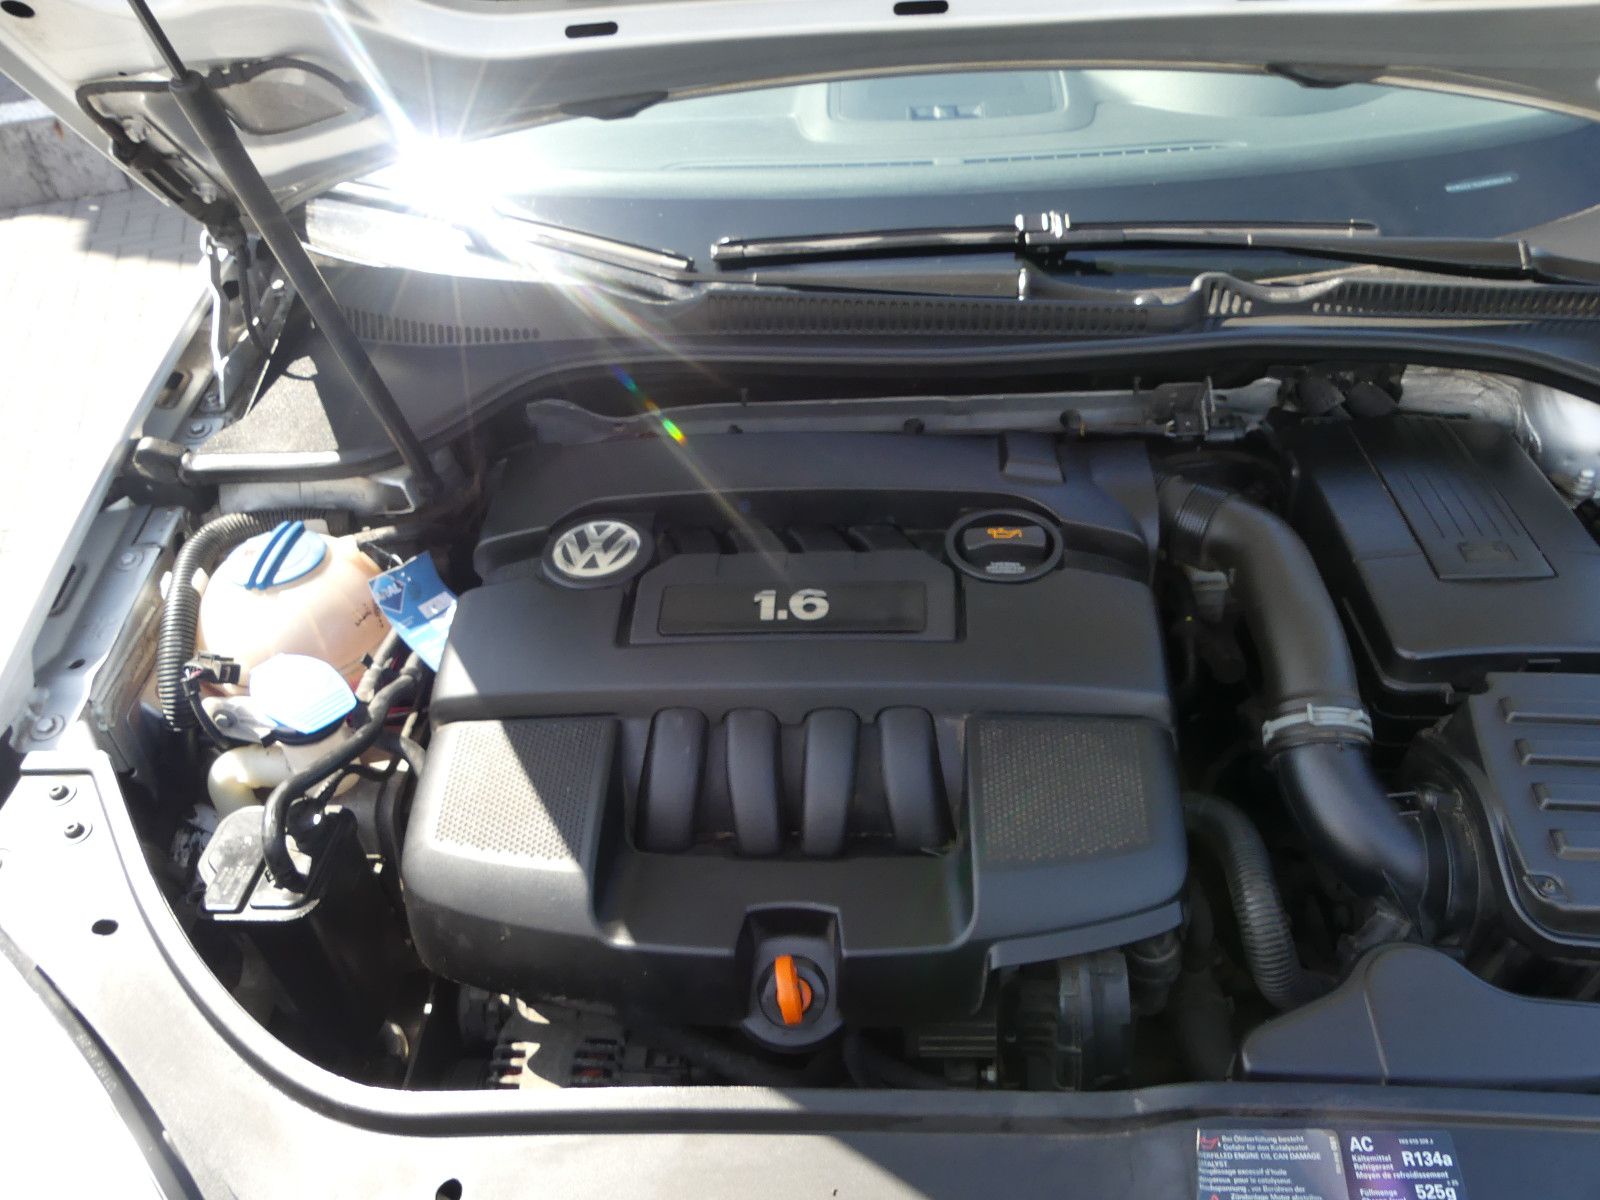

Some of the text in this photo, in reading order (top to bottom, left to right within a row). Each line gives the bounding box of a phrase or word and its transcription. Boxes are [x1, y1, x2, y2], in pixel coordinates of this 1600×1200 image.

[754, 588, 829, 621] 1.6
[1278, 1135, 1304, 1143] besteht
[1350, 1136, 1374, 1152] AC
[1199, 1151, 1321, 1160] VERFILLED ENGINE OIL CAN DAMAGE
[1402, 1150, 1453, 1168] R134a
[1199, 1160, 1227, 1168] ATALYST
[1354, 1162, 1394, 1171] Refrigerant
[1356, 1171, 1381, 1180] Moyen
[1382, 1171, 1392, 1179] de
[1414, 1183, 1457, 1200] 525g
